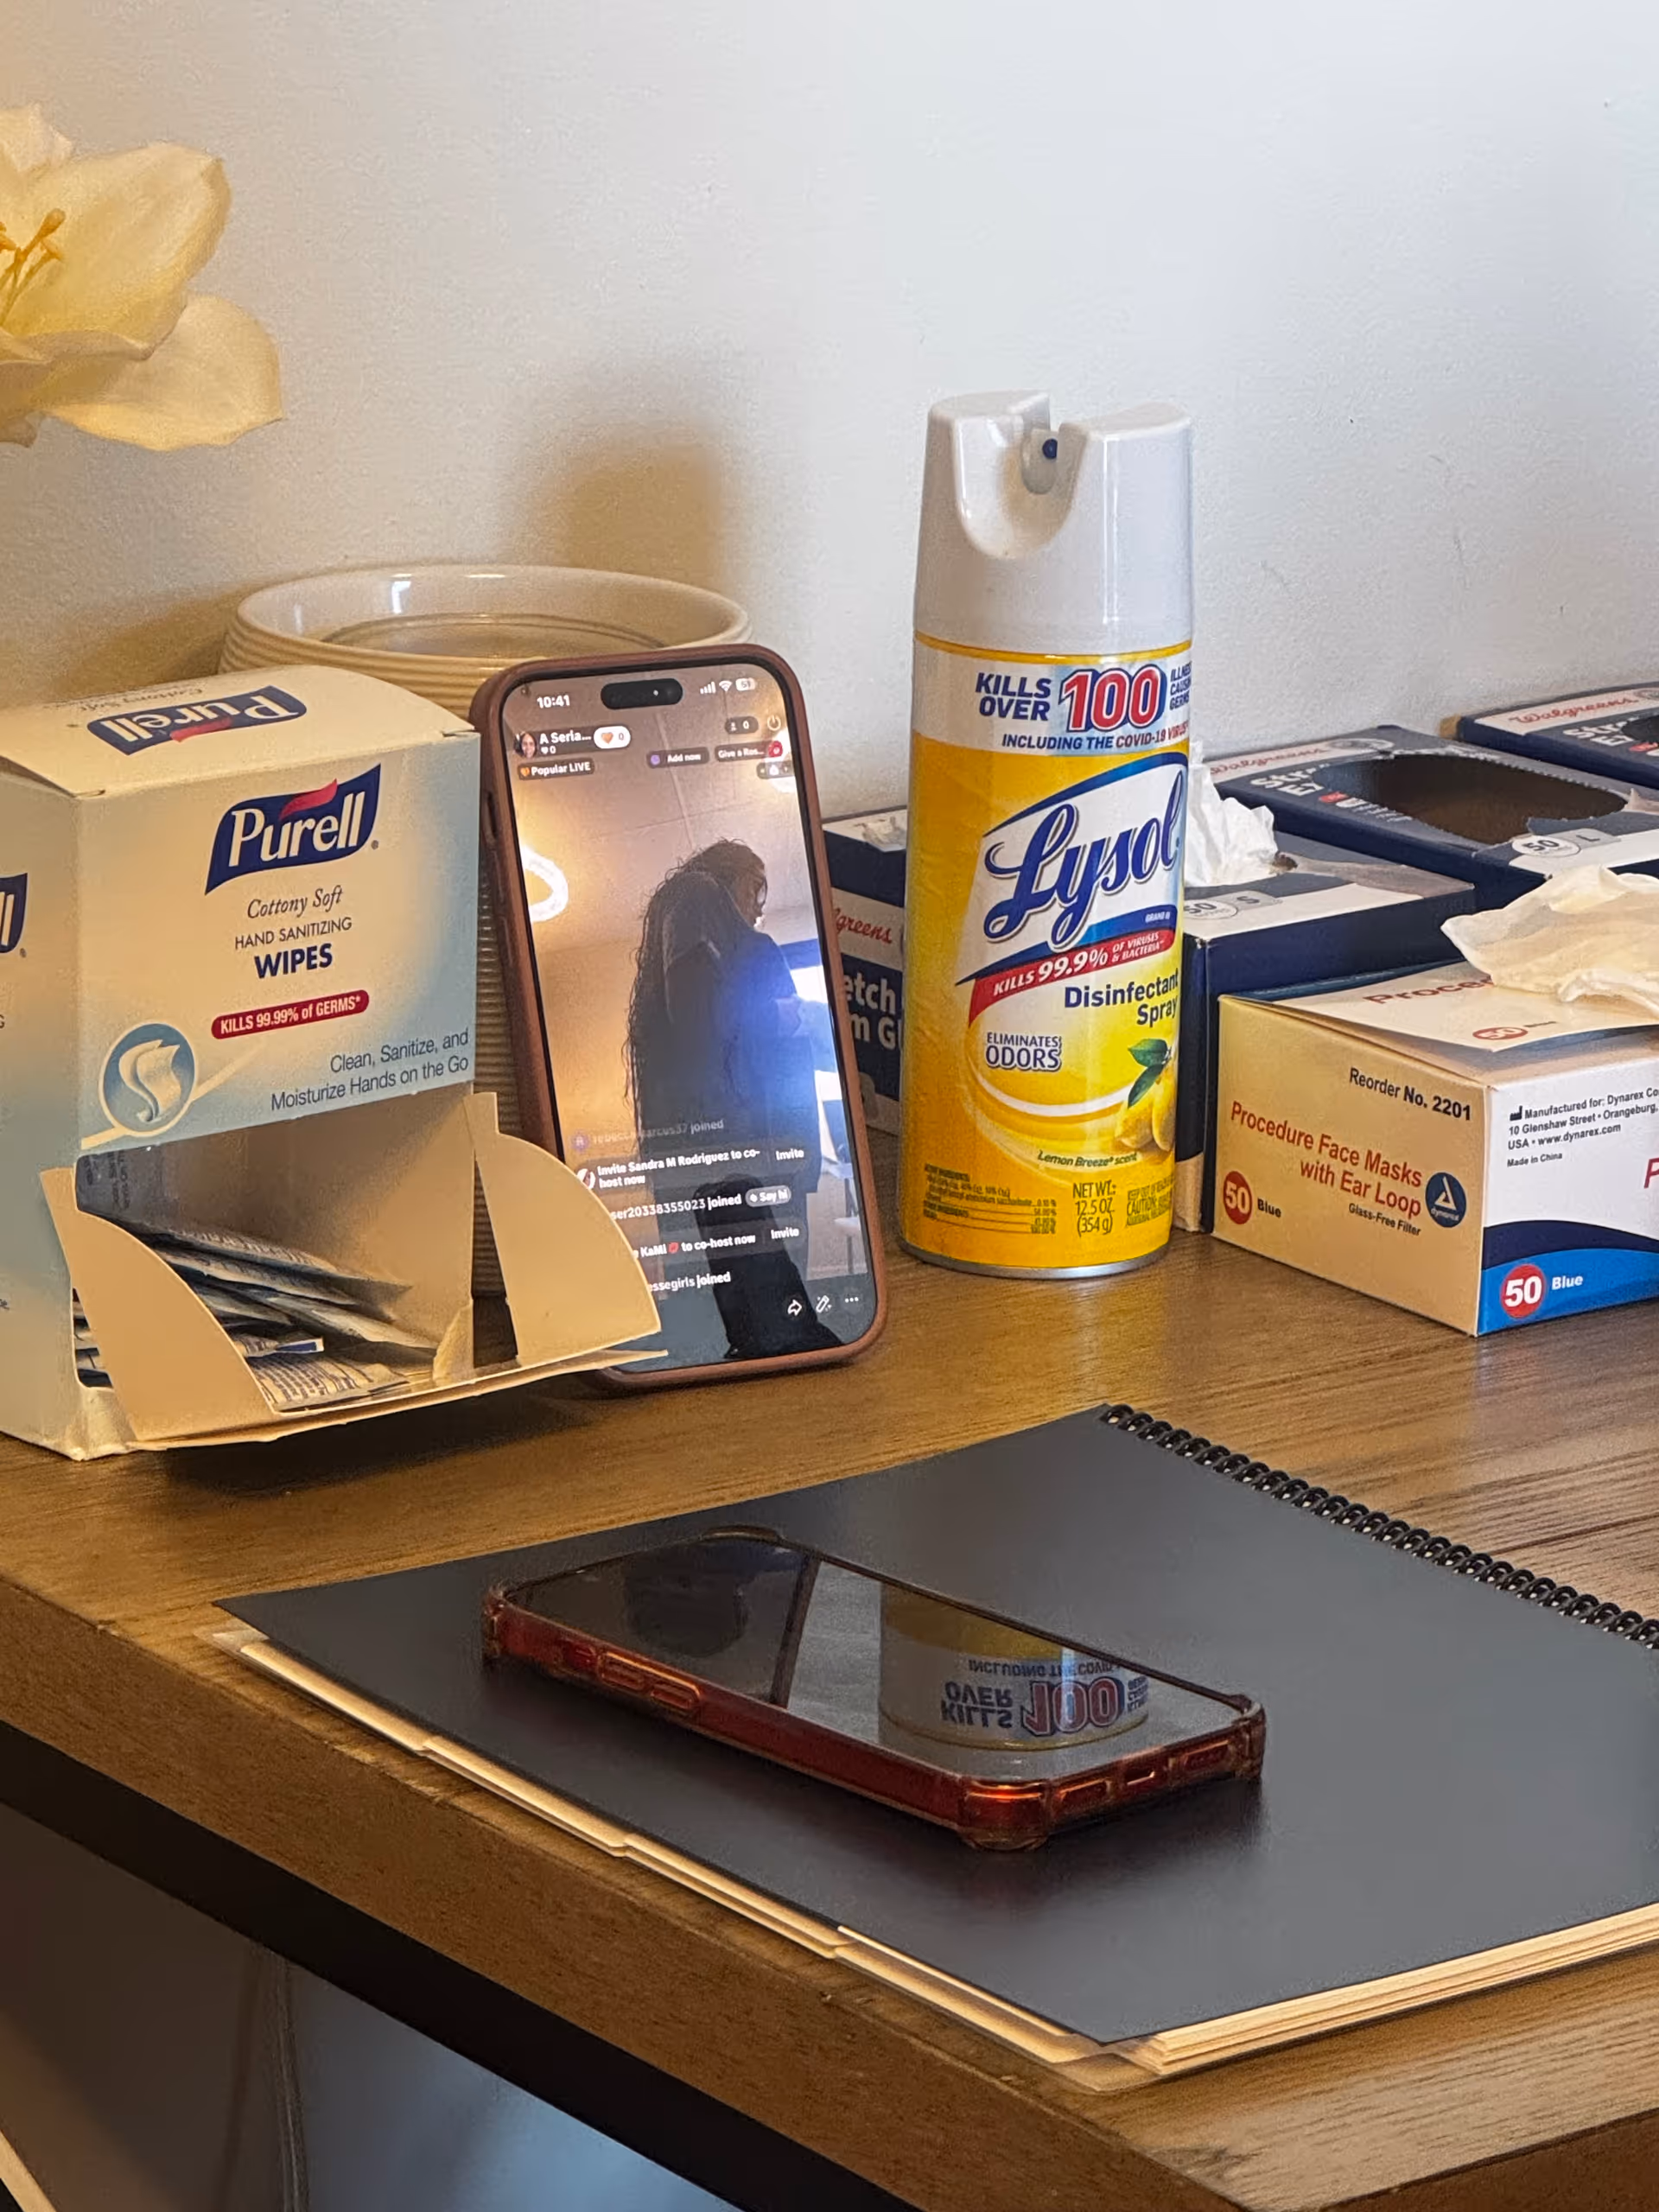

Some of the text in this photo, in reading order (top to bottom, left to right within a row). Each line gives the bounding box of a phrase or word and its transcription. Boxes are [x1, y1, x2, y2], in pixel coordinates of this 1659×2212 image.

[976, 672, 1052, 698] KILLS
[537, 695, 570, 709] 10:41
[979, 696, 1051, 721] OVER
[1058, 664, 1166, 733] 100
[1509, 697, 1639, 724] Walgreens
[100, 695, 300, 743] Purell
[540, 734, 549, 745] A
[1002, 734, 1082, 750] INCLUDING
[1085, 735, 1114, 749] THE
[1116, 728, 1166, 749] COVID-19
[531, 761, 591, 777] Popular LIVE
[228, 791, 365, 867] Purell
[983, 770, 1184, 946] Lysol
[1522, 839, 1560, 851] 50
[247, 885, 344, 918] Cottony Soft
[1236, 895, 1260, 905] S
[235, 917, 353, 950] HAND SANITIZING
[1112, 931, 1160, 952] OF VIRUSES
[253, 943, 334, 978] WIPES
[1111, 954, 1121, 963] &
[993, 949, 1109, 996] KILLS 99.9%
[843, 971, 897, 1017] etch
[1064, 968, 1179, 1008] Disinfectant
[220, 1014, 254, 1033] KILLS
[256, 1007, 299, 1027] 99.99%
[302, 1003, 314, 1018] of
[1136, 995, 1179, 1027] Spray
[330, 1028, 469, 1072] Clean, Sanitize, and
[986, 1031, 1060, 1048] ELIMINATES
[984, 1045, 1062, 1071] ODORS
[271, 1055, 469, 1111] Moisturize Hands on the Go
[1350, 1067, 1471, 1122] Reorder No. 2201
[1524, 1098, 1587, 1120] Manufactured
[1589, 1097, 1605, 1109] for:
[1607, 1091, 1643, 1107] Dynarex
[1508, 1123, 1622, 1150] USA www.dynarex.com
[1510, 1125, 1520, 1136] 10
[1522, 1119, 1567, 1135] Glenshaw
[1569, 1113, 1596, 1127] Street
[776, 1148, 804, 1160] Invite
[1038, 1149, 1073, 1166] Lemon
[1115, 1152, 1137, 1165] scent
[1231, 1101, 1423, 1188] Procedure Face Masks
[597, 1148, 760, 1177] Invite Sandra M Rodriguez to co-
[1507, 1152, 1563, 1167] Made in China
[599, 1175, 645, 1189] host now
[1072, 1183, 1093, 1198] NET
[1300, 1160, 1421, 1219] with Ear Loop
[611, 1194, 742, 1220] ser20338355023 joined
[1076, 1199, 1097, 1216] 12.5
[1224, 1180, 1281, 1218] 50 Blue
[1077, 1215, 1100, 1237] (354
[1101, 1213, 1114, 1236] g)
[1348, 1202, 1421, 1236] Glass-Free Filter
[681, 1242, 693, 1252] to
[694, 1236, 734, 1251] co-host
[734, 1234, 756, 1246] now
[771, 1226, 799, 1240] Invite
[649, 1271, 732, 1293] essegirls joined
[1504, 1274, 1584, 1309] 50 Blue
